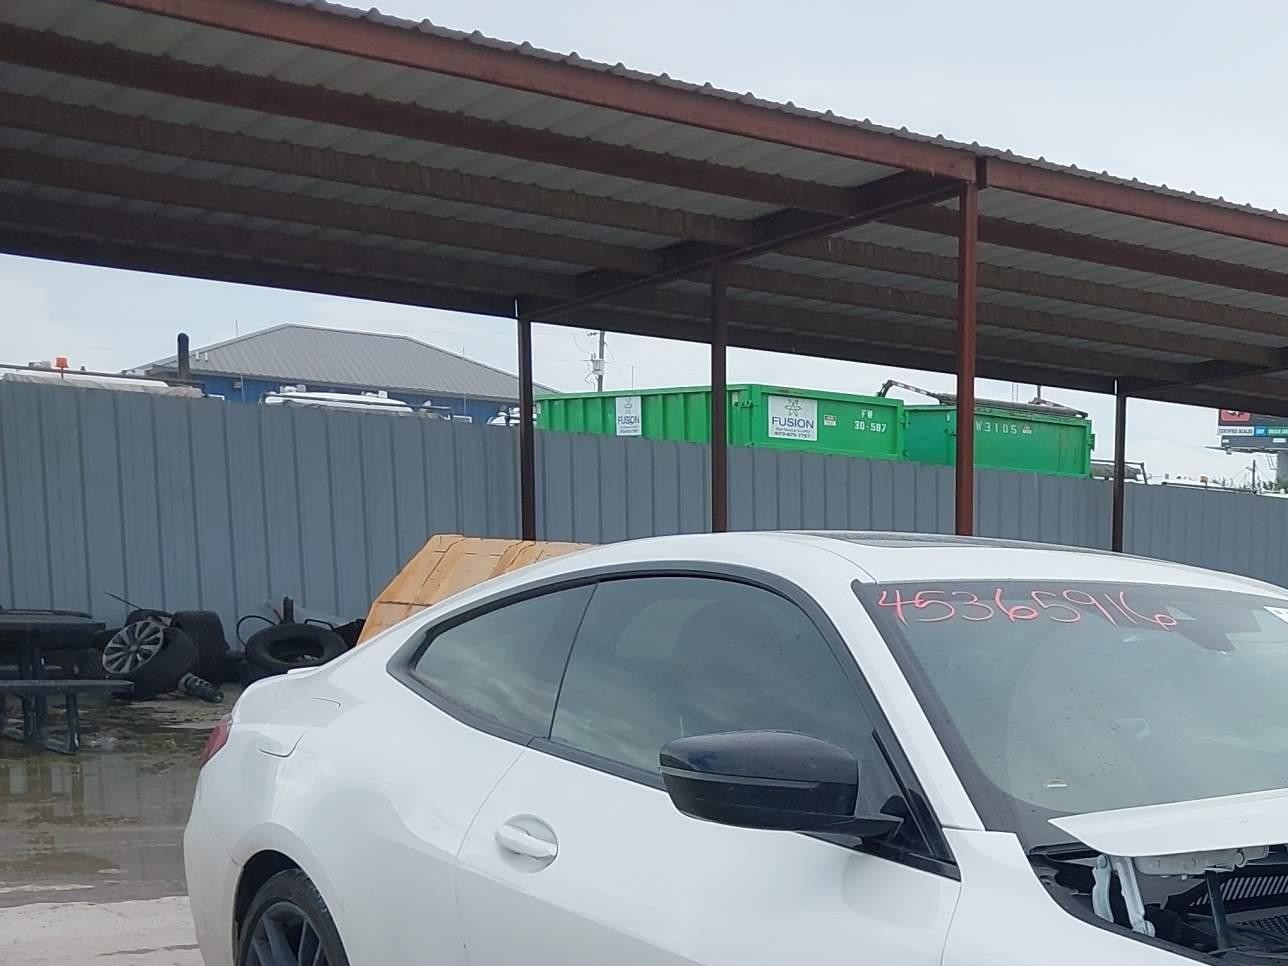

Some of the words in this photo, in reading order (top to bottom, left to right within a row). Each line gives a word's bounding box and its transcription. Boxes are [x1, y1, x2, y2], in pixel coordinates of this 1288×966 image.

[617, 415, 640, 425] FUSION
[772, 416, 814, 429] FUSION
[878, 588, 1178, 631] 45365916
